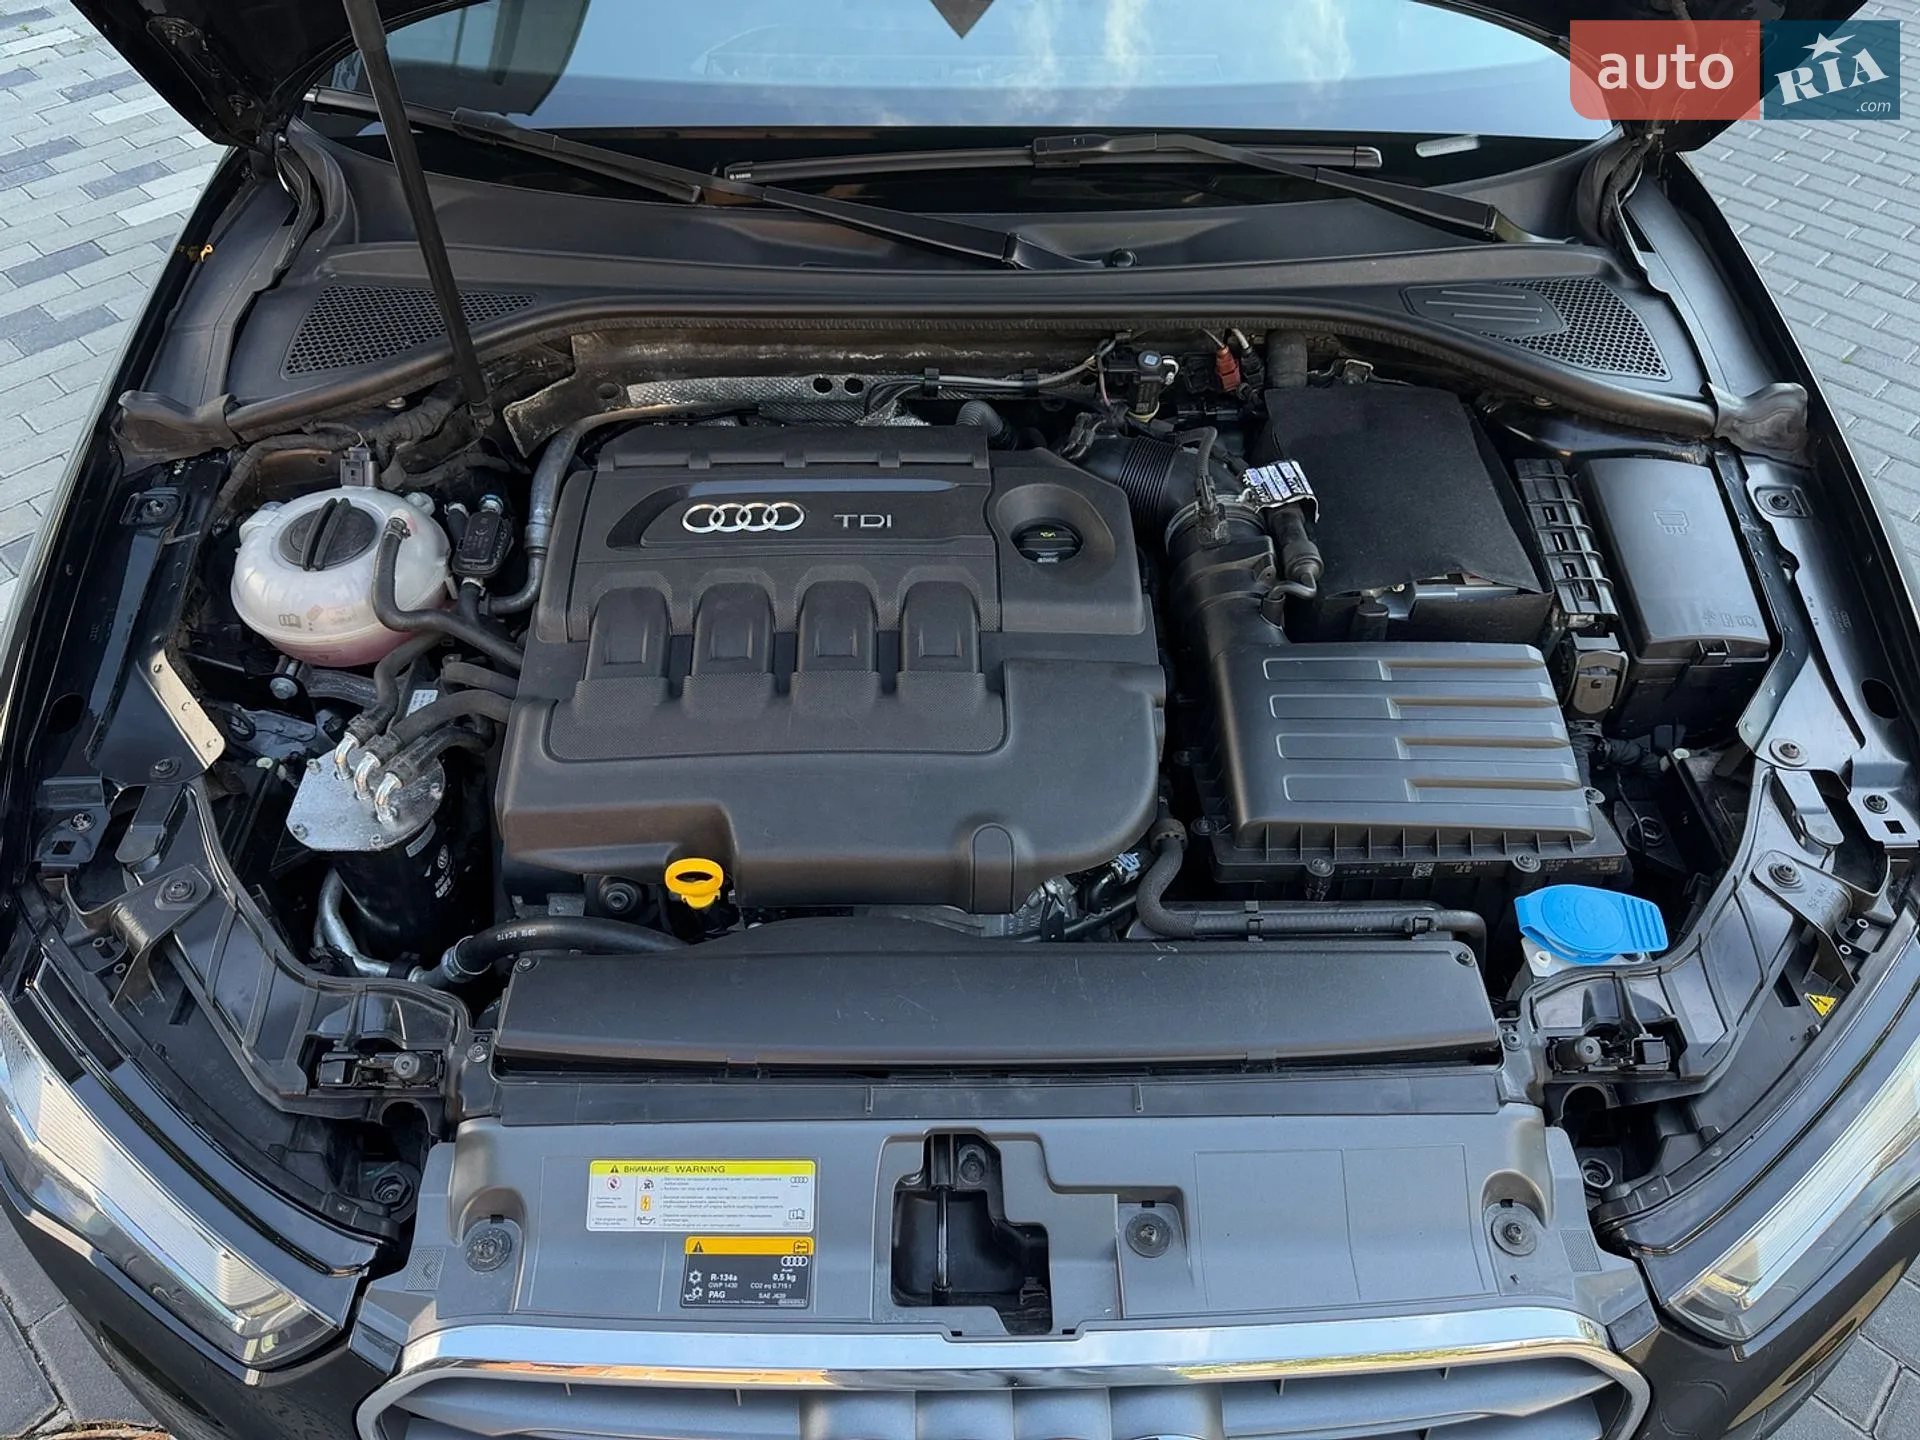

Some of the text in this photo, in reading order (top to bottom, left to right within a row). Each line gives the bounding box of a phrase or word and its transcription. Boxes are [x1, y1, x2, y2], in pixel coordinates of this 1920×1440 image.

[834, 514, 892, 528] TDI
[623, 1165, 726, 1173] ВНИМАНИЕ WARNING
[710, 1273, 738, 1281] R-134a
[786, 1273, 796, 1283] kg
[708, 1290, 726, 1298] PAG
